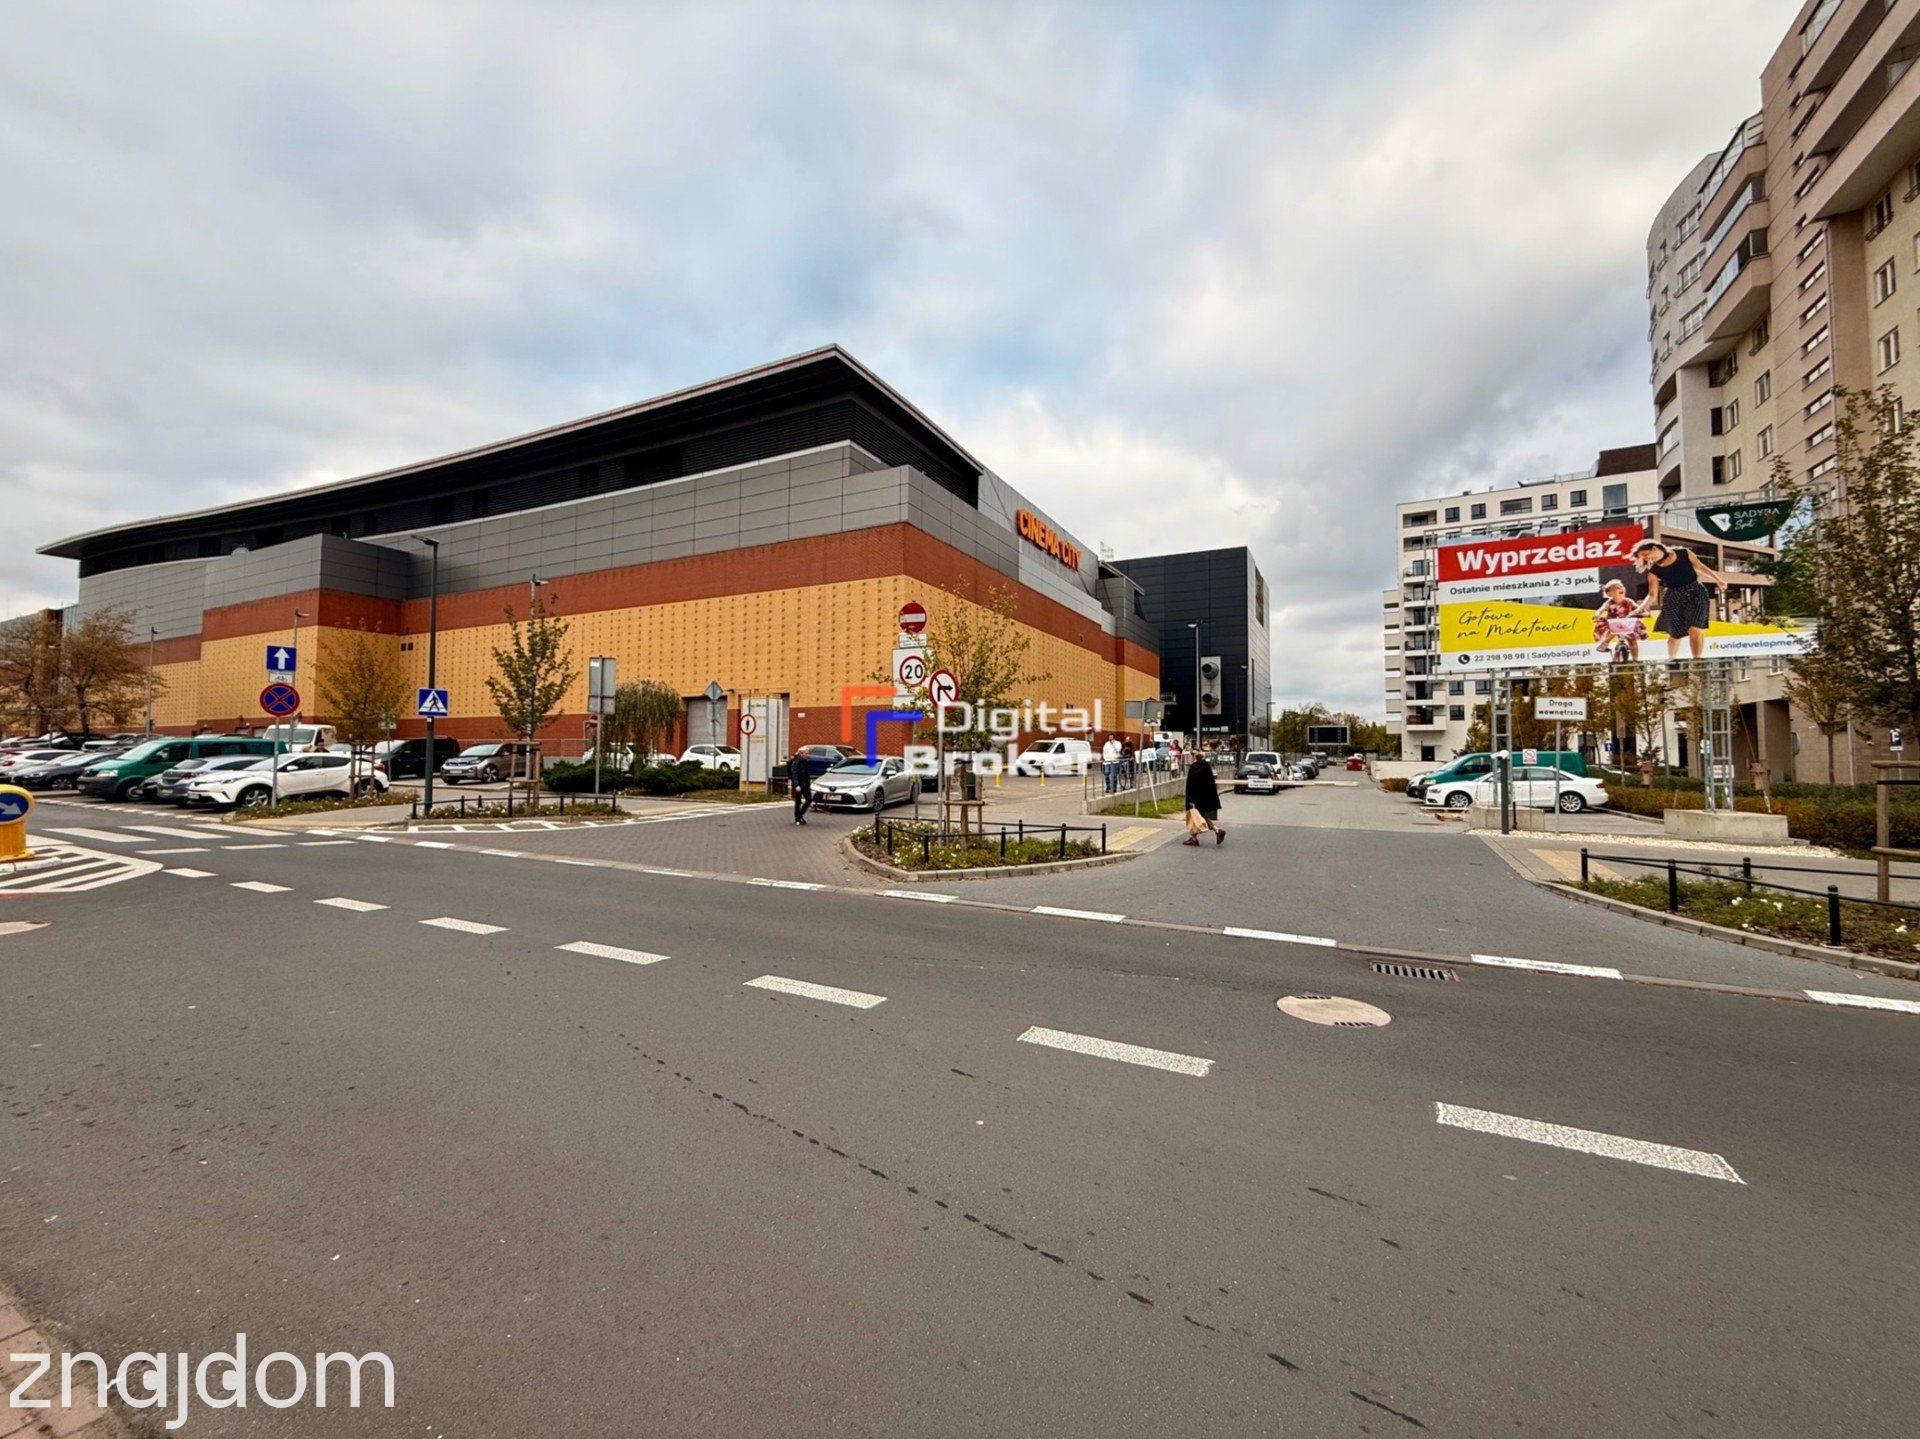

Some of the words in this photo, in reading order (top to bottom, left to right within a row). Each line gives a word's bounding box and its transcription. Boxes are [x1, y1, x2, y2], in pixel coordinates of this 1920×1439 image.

[1017, 508, 1060, 559] CINEMA
[1060, 539, 1082, 571] CITY
[1456, 533, 1622, 575] Wyprzedaż
[1450, 585, 1490, 595] Ostatnie
[1493, 579, 1551, 592] mieszkania
[1553, 578, 1572, 586] 2-3
[1575, 575, 1598, 587] pok.
[1459, 607, 1514, 625] Gotowe
[1456, 630, 1479, 639] na
[1486, 618, 1578, 639] Mokotowie!
[1531, 649, 1591, 660] SadybaSpot.pl
[904, 664, 924, 679] 20
[1549, 699, 1573, 708] Droga
